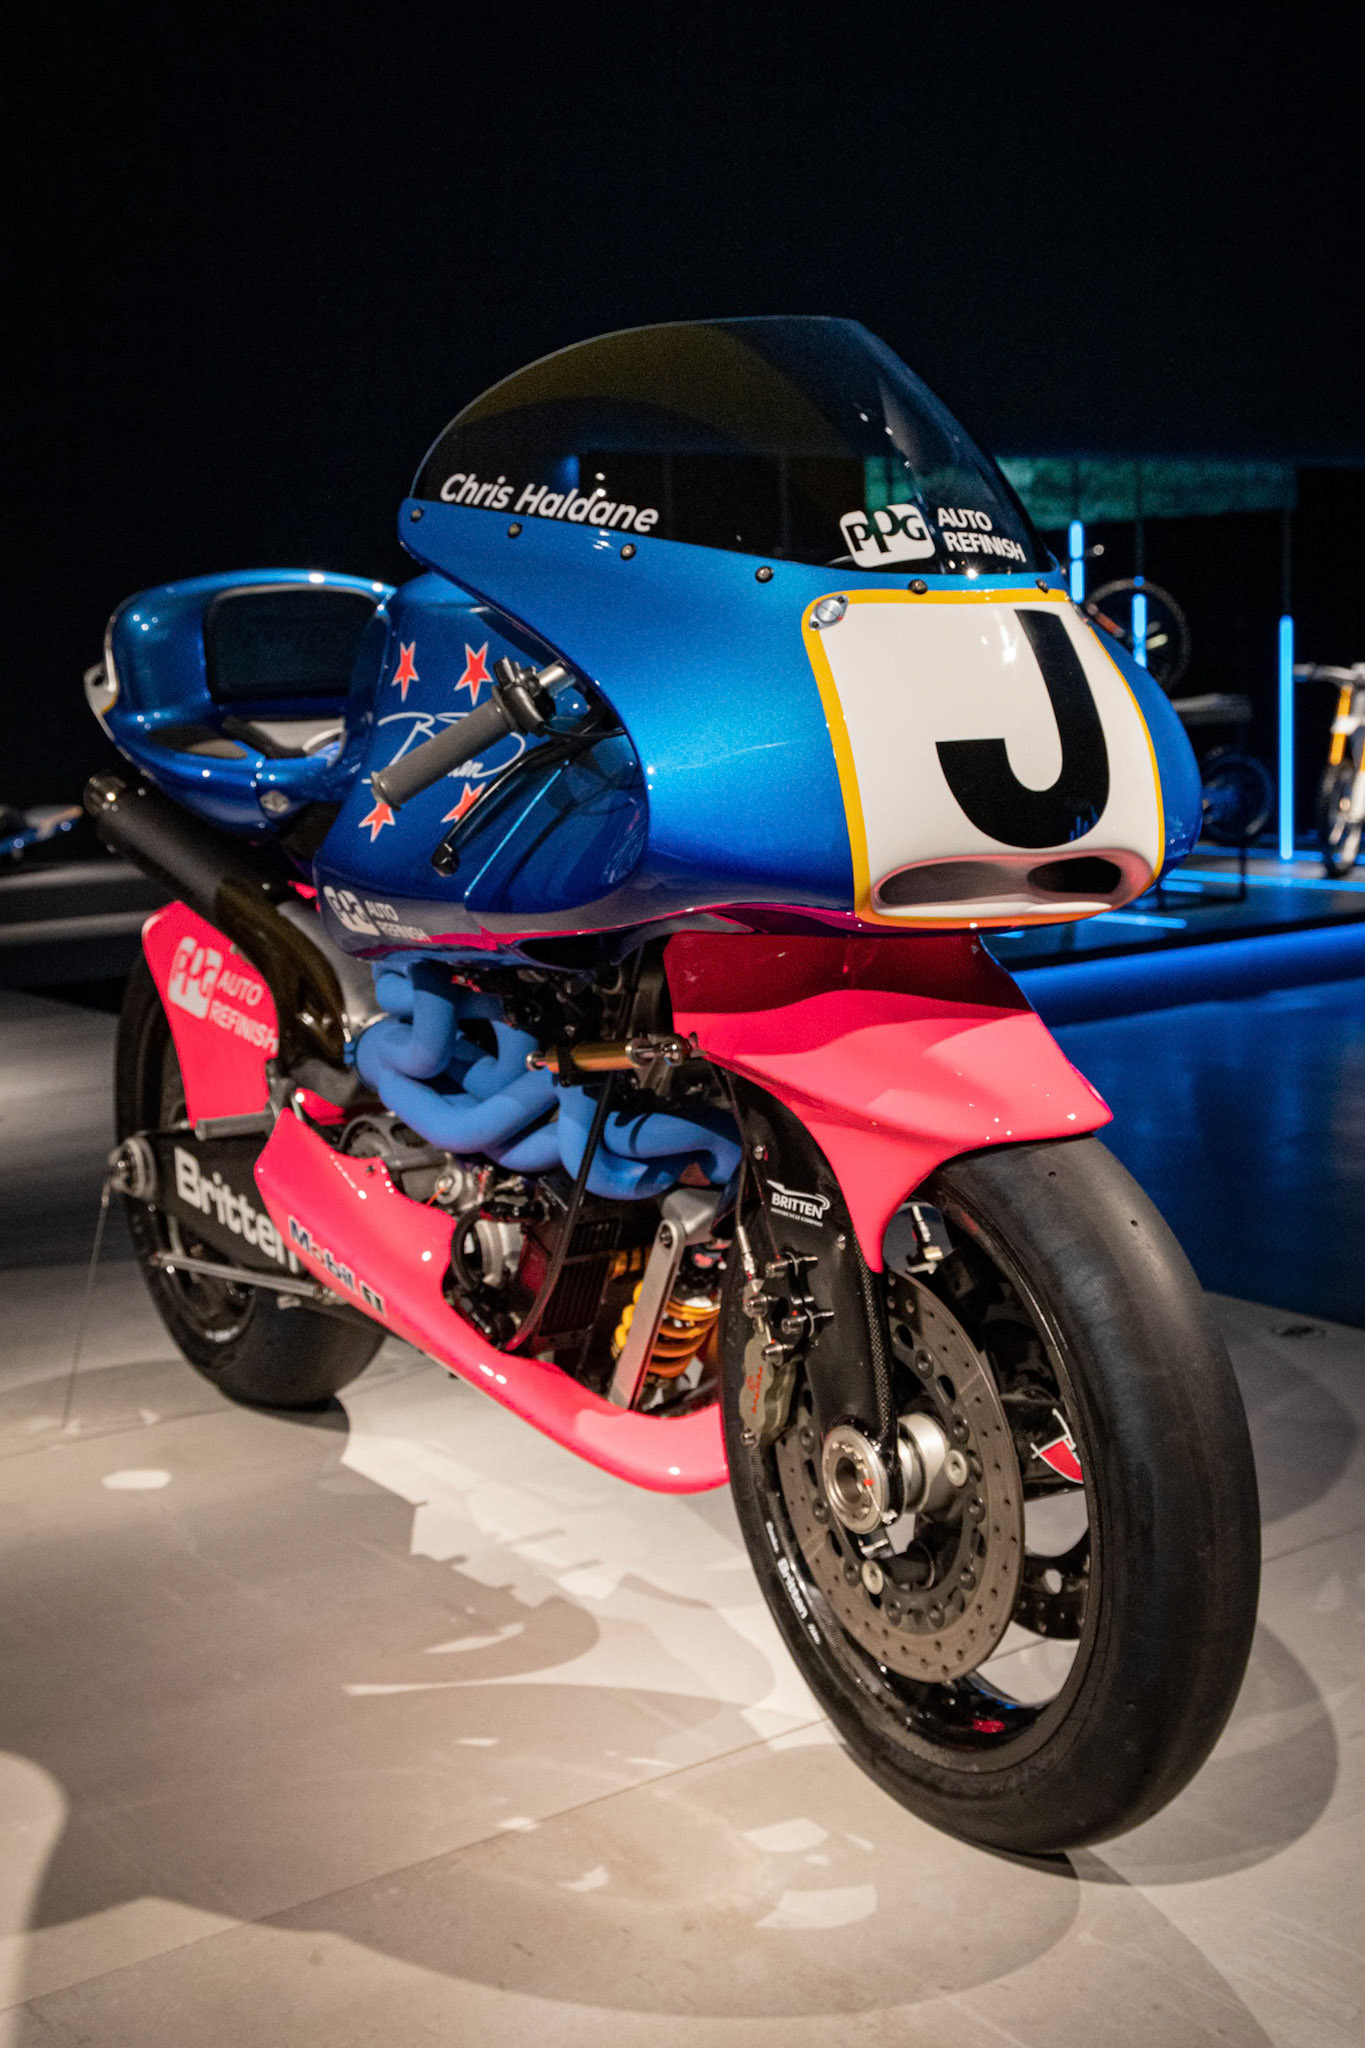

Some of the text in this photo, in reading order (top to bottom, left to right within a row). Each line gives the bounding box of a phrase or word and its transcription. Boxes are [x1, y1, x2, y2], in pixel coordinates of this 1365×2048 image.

[440, 473, 659, 532] Chris Haldane
[937, 507, 993, 531] AUTO
[843, 503, 931, 558] PPG
[942, 531, 1027, 563] REFINISH
[935, 609, 1110, 849] J
[217, 970, 263, 1006] AUTO
[209, 1000, 279, 1054] REFINISH
[174, 1145, 298, 1274] Britten
[771, 1192, 823, 1219] BRITTEN
[288, 1215, 357, 1294] Mobil
